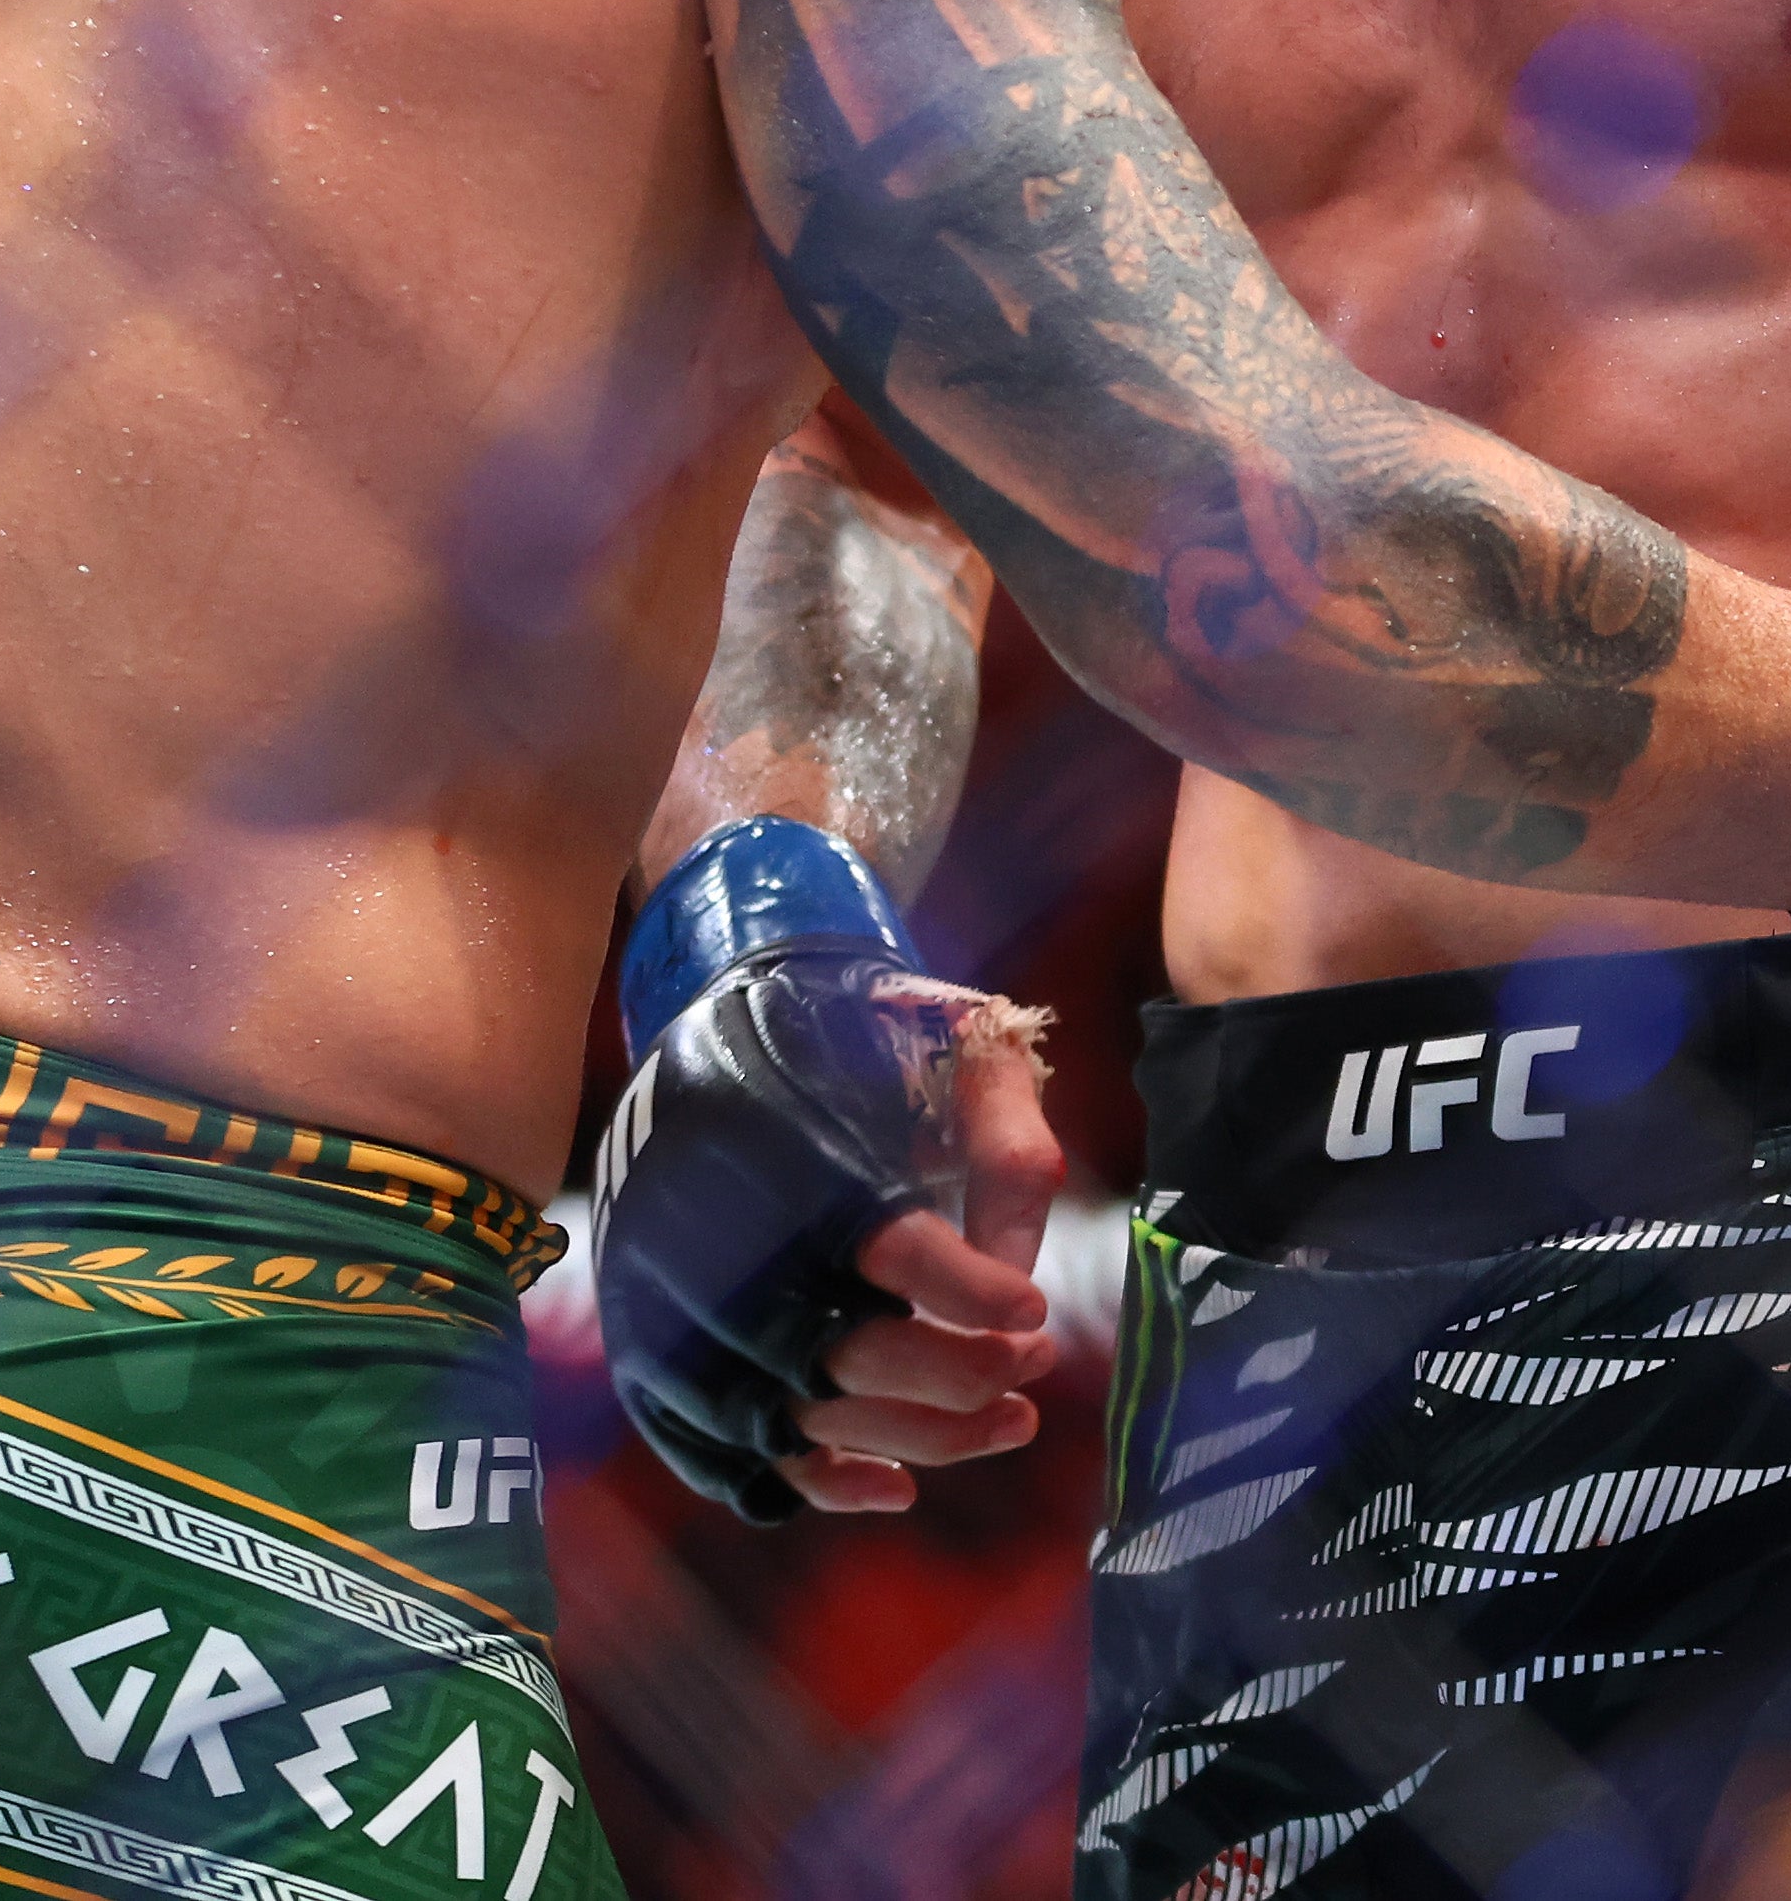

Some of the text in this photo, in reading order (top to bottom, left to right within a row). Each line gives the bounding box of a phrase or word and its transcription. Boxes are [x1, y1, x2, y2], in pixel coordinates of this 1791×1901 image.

[1324, 1024, 1581, 1162] UFC
[409, 1436, 544, 1530] UF
[27, 1606, 576, 1901] GREAT
